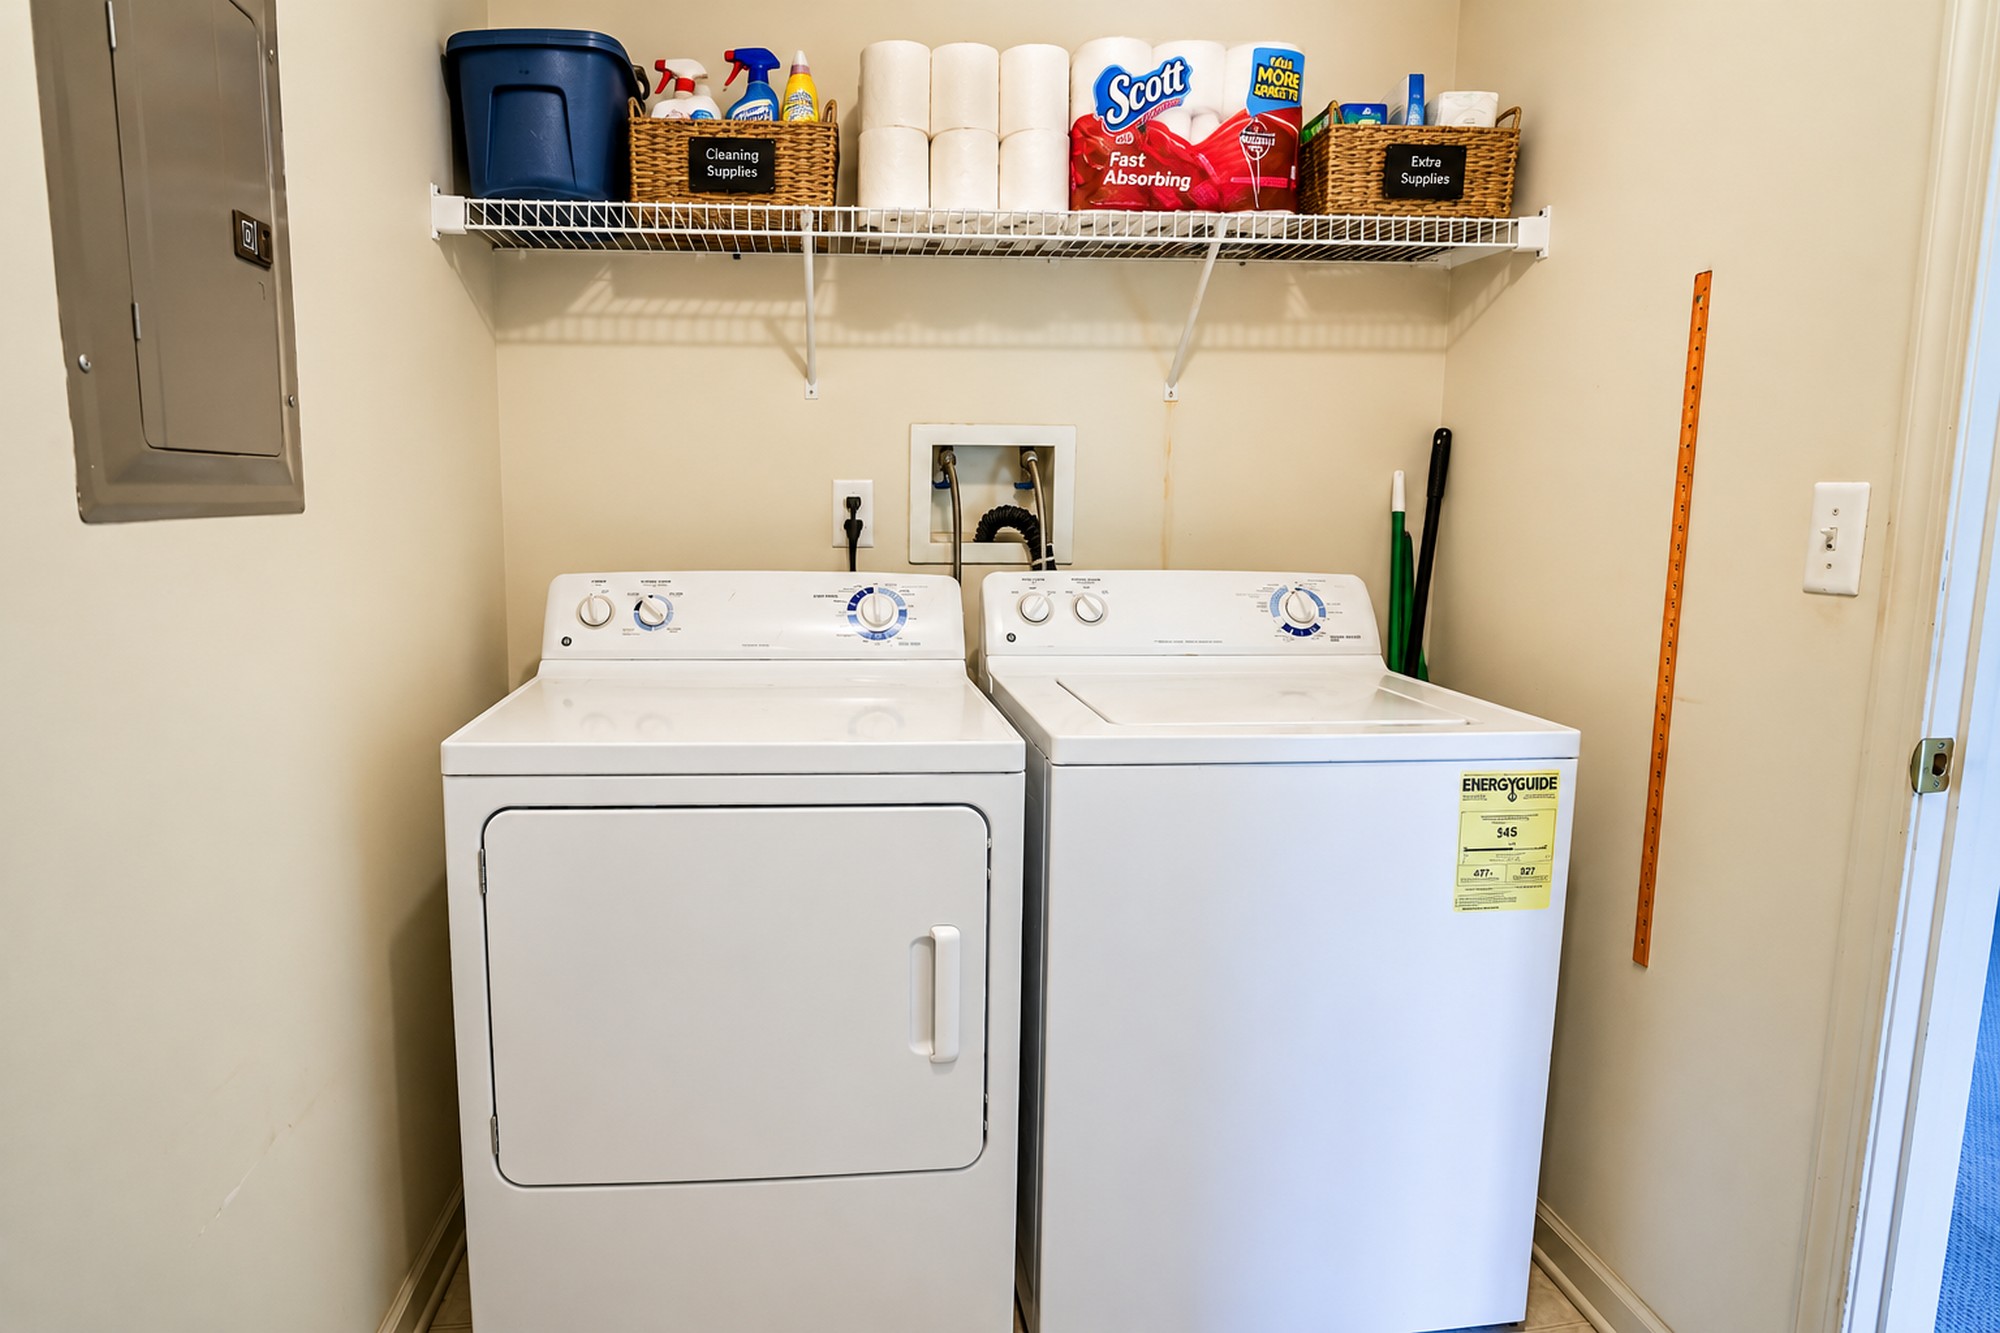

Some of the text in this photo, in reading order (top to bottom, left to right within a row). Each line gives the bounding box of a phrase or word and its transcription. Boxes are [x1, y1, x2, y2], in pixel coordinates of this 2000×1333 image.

[1257, 66, 1300, 90] MORE
[1106, 60, 1185, 125] Scott
[705, 148, 760, 164] Cleaning
[1109, 151, 1146, 168] Fast
[1411, 155, 1441, 168] Extra
[706, 165, 758, 179] Supplies
[1102, 169, 1191, 192] Absorbing
[1400, 172, 1450, 188] Supplies
[1462, 776, 1558, 794] ENERGYGUIDE
